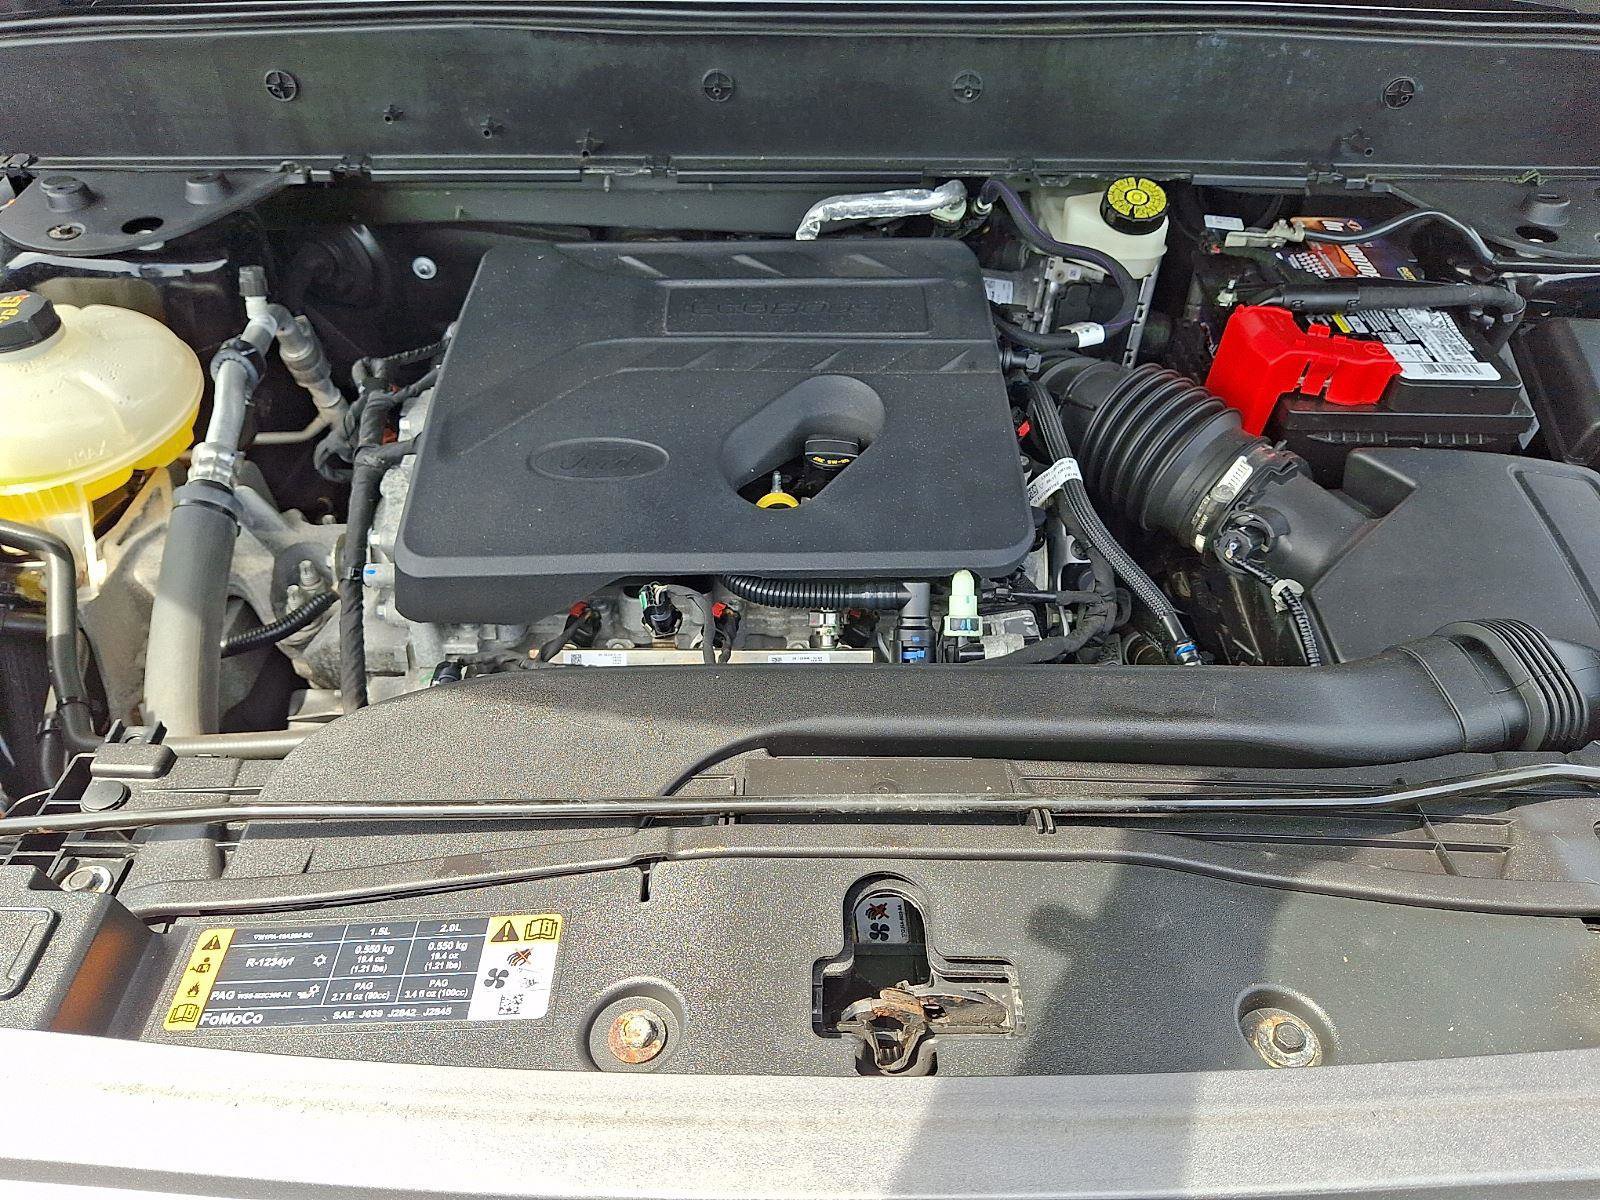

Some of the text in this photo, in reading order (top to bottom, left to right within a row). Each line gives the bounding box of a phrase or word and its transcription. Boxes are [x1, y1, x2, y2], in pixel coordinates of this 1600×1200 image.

[369, 926, 391, 936] 1.5L
[439, 923, 462, 933] 2.0L
[354, 943, 396, 955] 0.550 kg
[427, 941, 469, 952] 0.550 kg
[245, 956, 296, 969] R-1234yf
[353, 981, 374, 991] PAG
[428, 979, 449, 988] PAG
[210, 990, 236, 1001] PAG
[331, 992, 343, 1002] 2.7
[199, 1012, 264, 1026] FoMoCo
[332, 1010, 356, 1020] SAE
